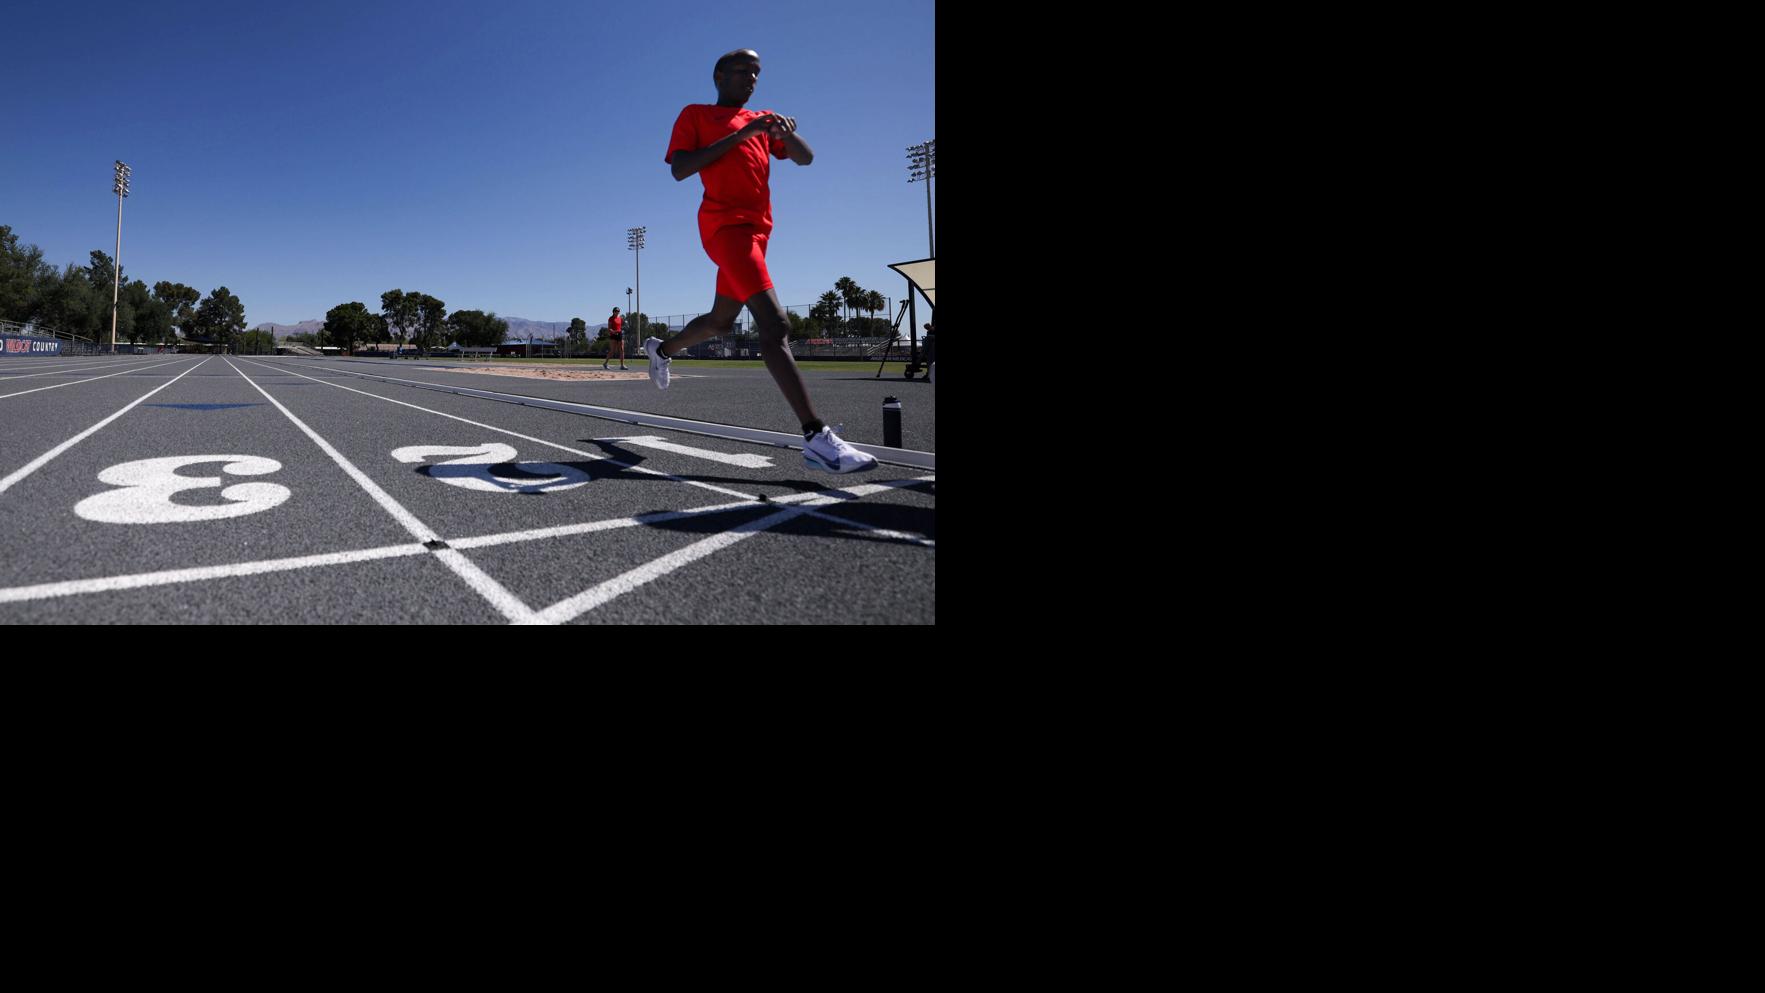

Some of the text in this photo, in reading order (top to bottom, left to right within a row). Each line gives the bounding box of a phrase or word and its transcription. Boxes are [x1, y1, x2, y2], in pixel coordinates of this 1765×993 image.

[33, 341, 58, 352] COUNTRY
[74, 454, 291, 524] 3
[391, 442, 591, 493] 2
